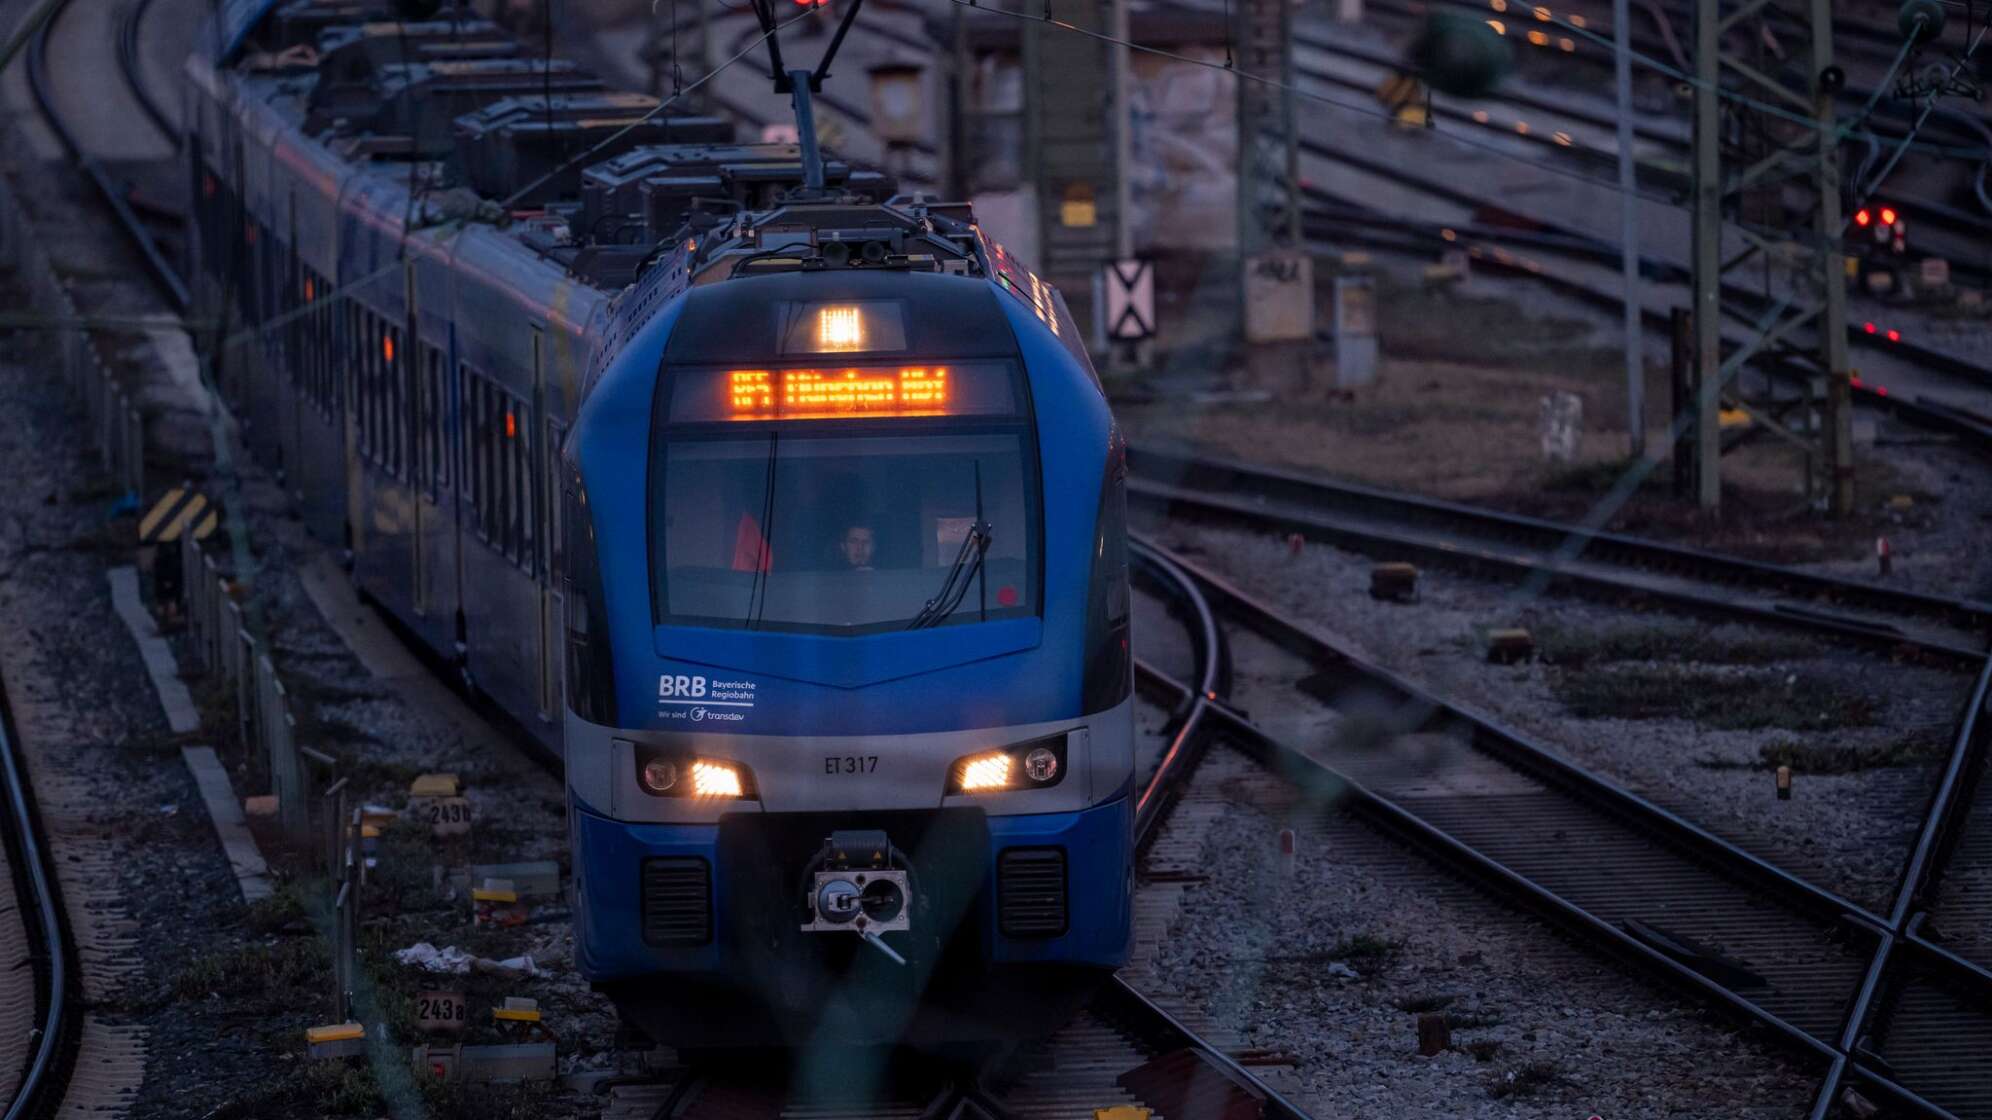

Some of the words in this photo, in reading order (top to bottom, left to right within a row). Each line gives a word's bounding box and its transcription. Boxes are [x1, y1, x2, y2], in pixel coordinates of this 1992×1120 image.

[659, 675, 706, 697] BRB
[712, 680, 756, 690] Bayerische
[711, 690, 755, 700] Regiobahn
[671, 711, 687, 719] sind
[707, 711, 744, 720] transdev
[825, 757, 841, 774] ET
[845, 756, 879, 774] 317
